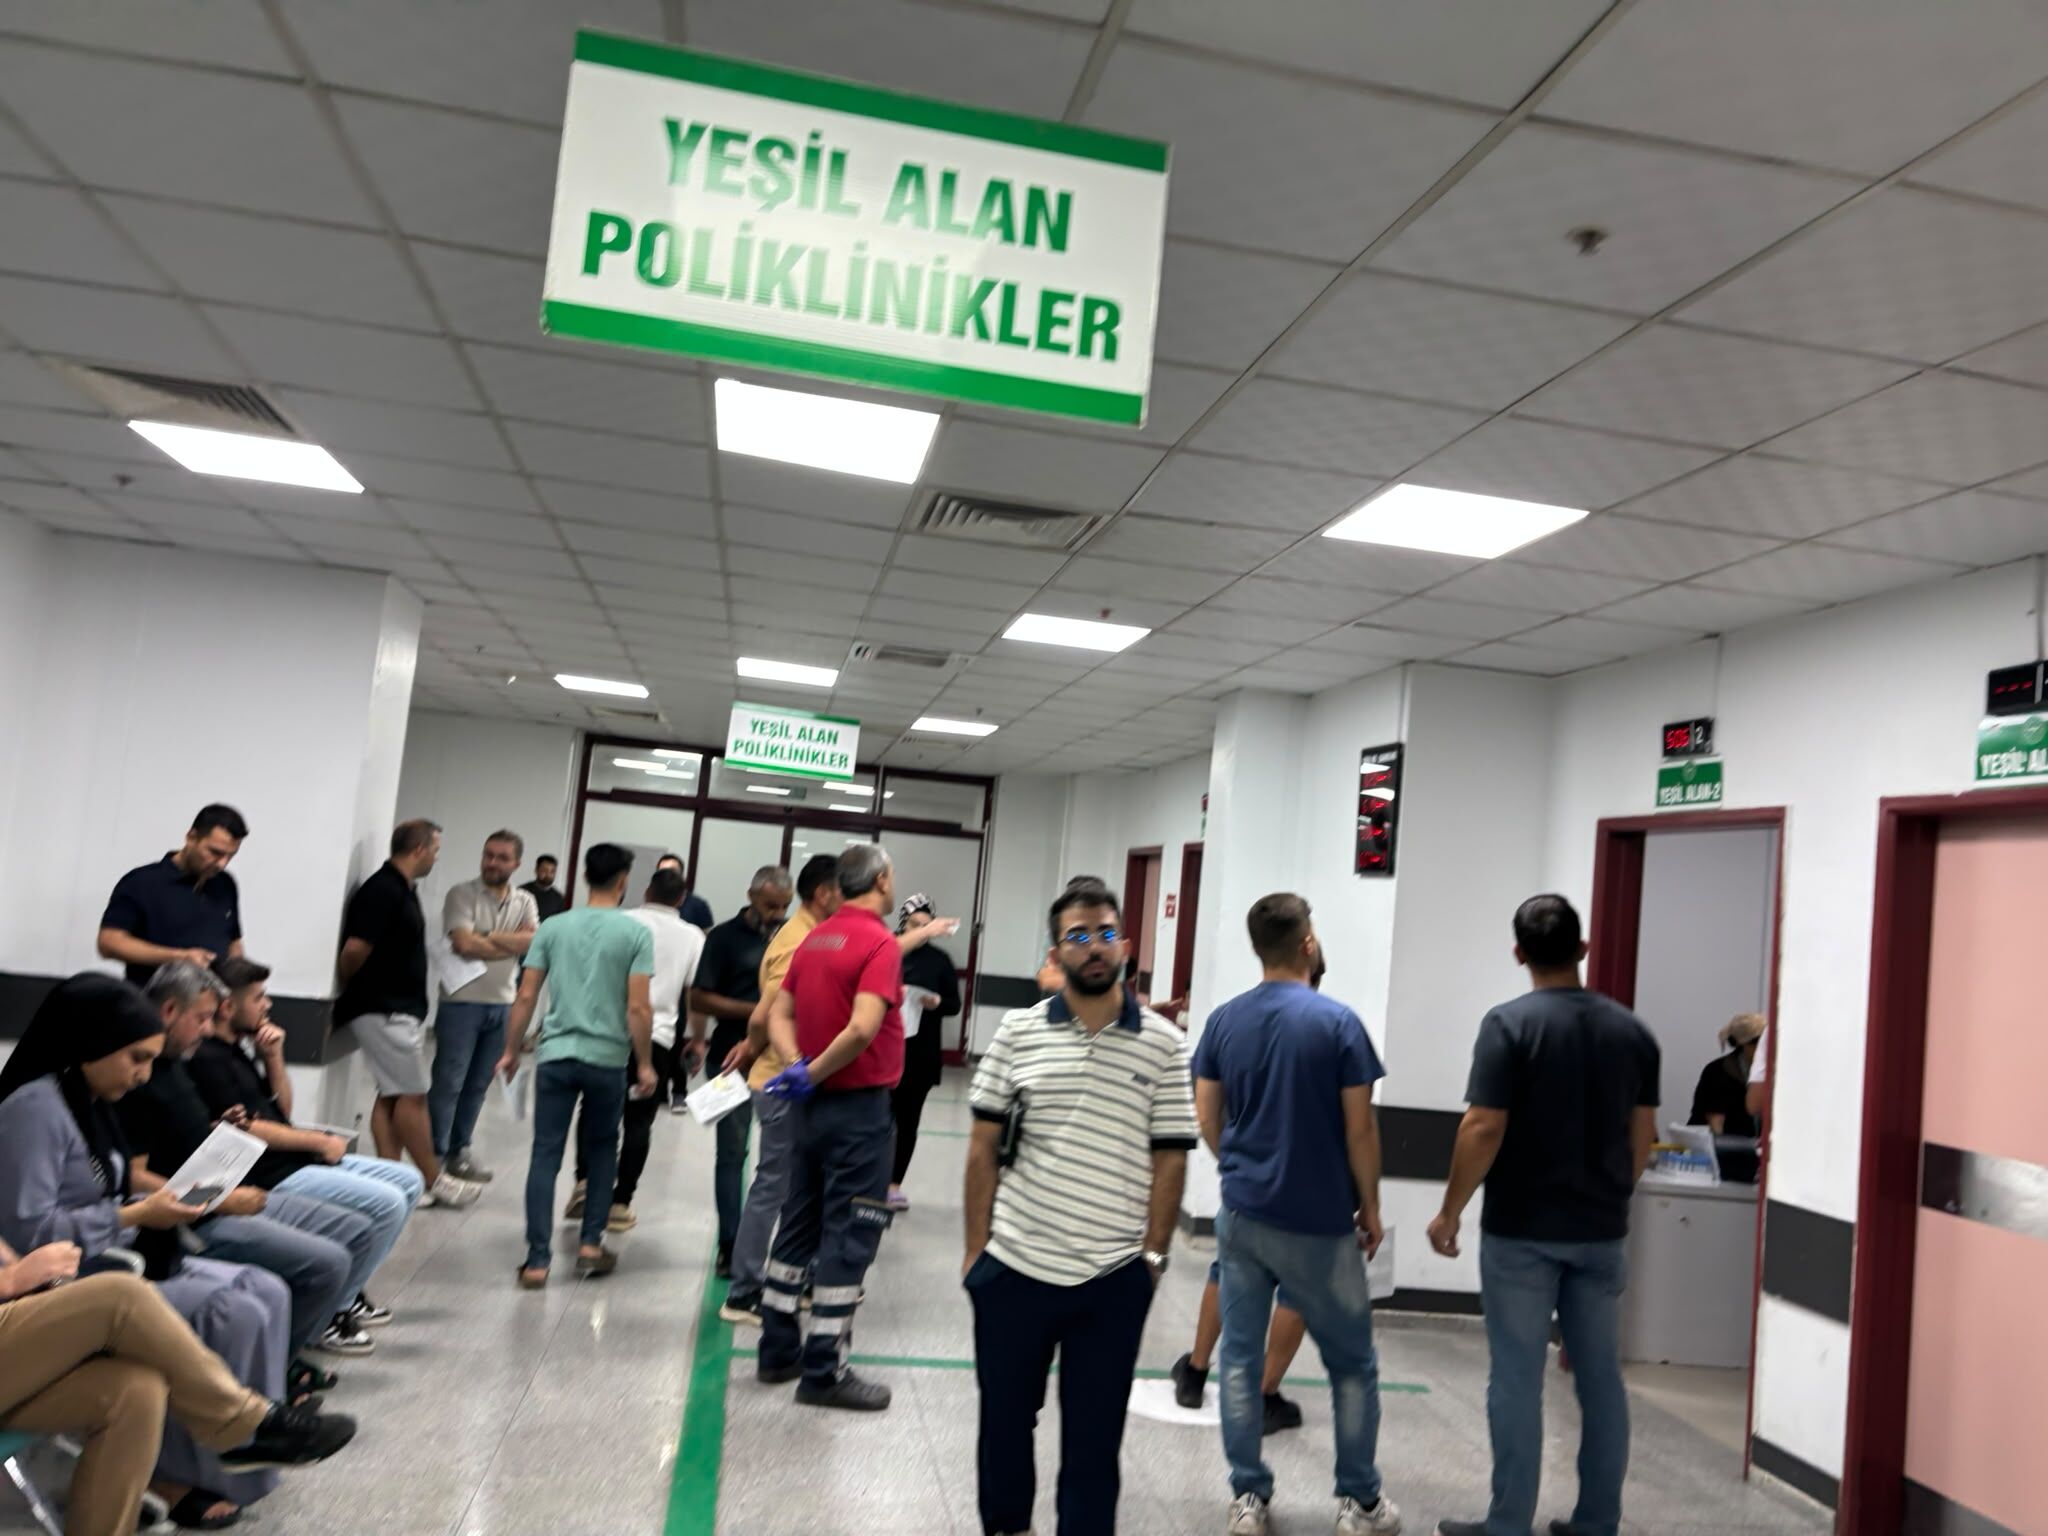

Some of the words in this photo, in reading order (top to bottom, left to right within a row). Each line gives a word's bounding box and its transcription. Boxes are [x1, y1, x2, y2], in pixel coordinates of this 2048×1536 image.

[663, 116, 862, 217] YEŞİL
[883, 161, 1074, 252] ALAN
[581, 209, 1123, 362] POLİKLİNİKLER
[733, 739, 849, 768] POLİKLİNİKLER
[751, 718, 792, 740] YEŞİL
[797, 726, 839, 745] ALAN
